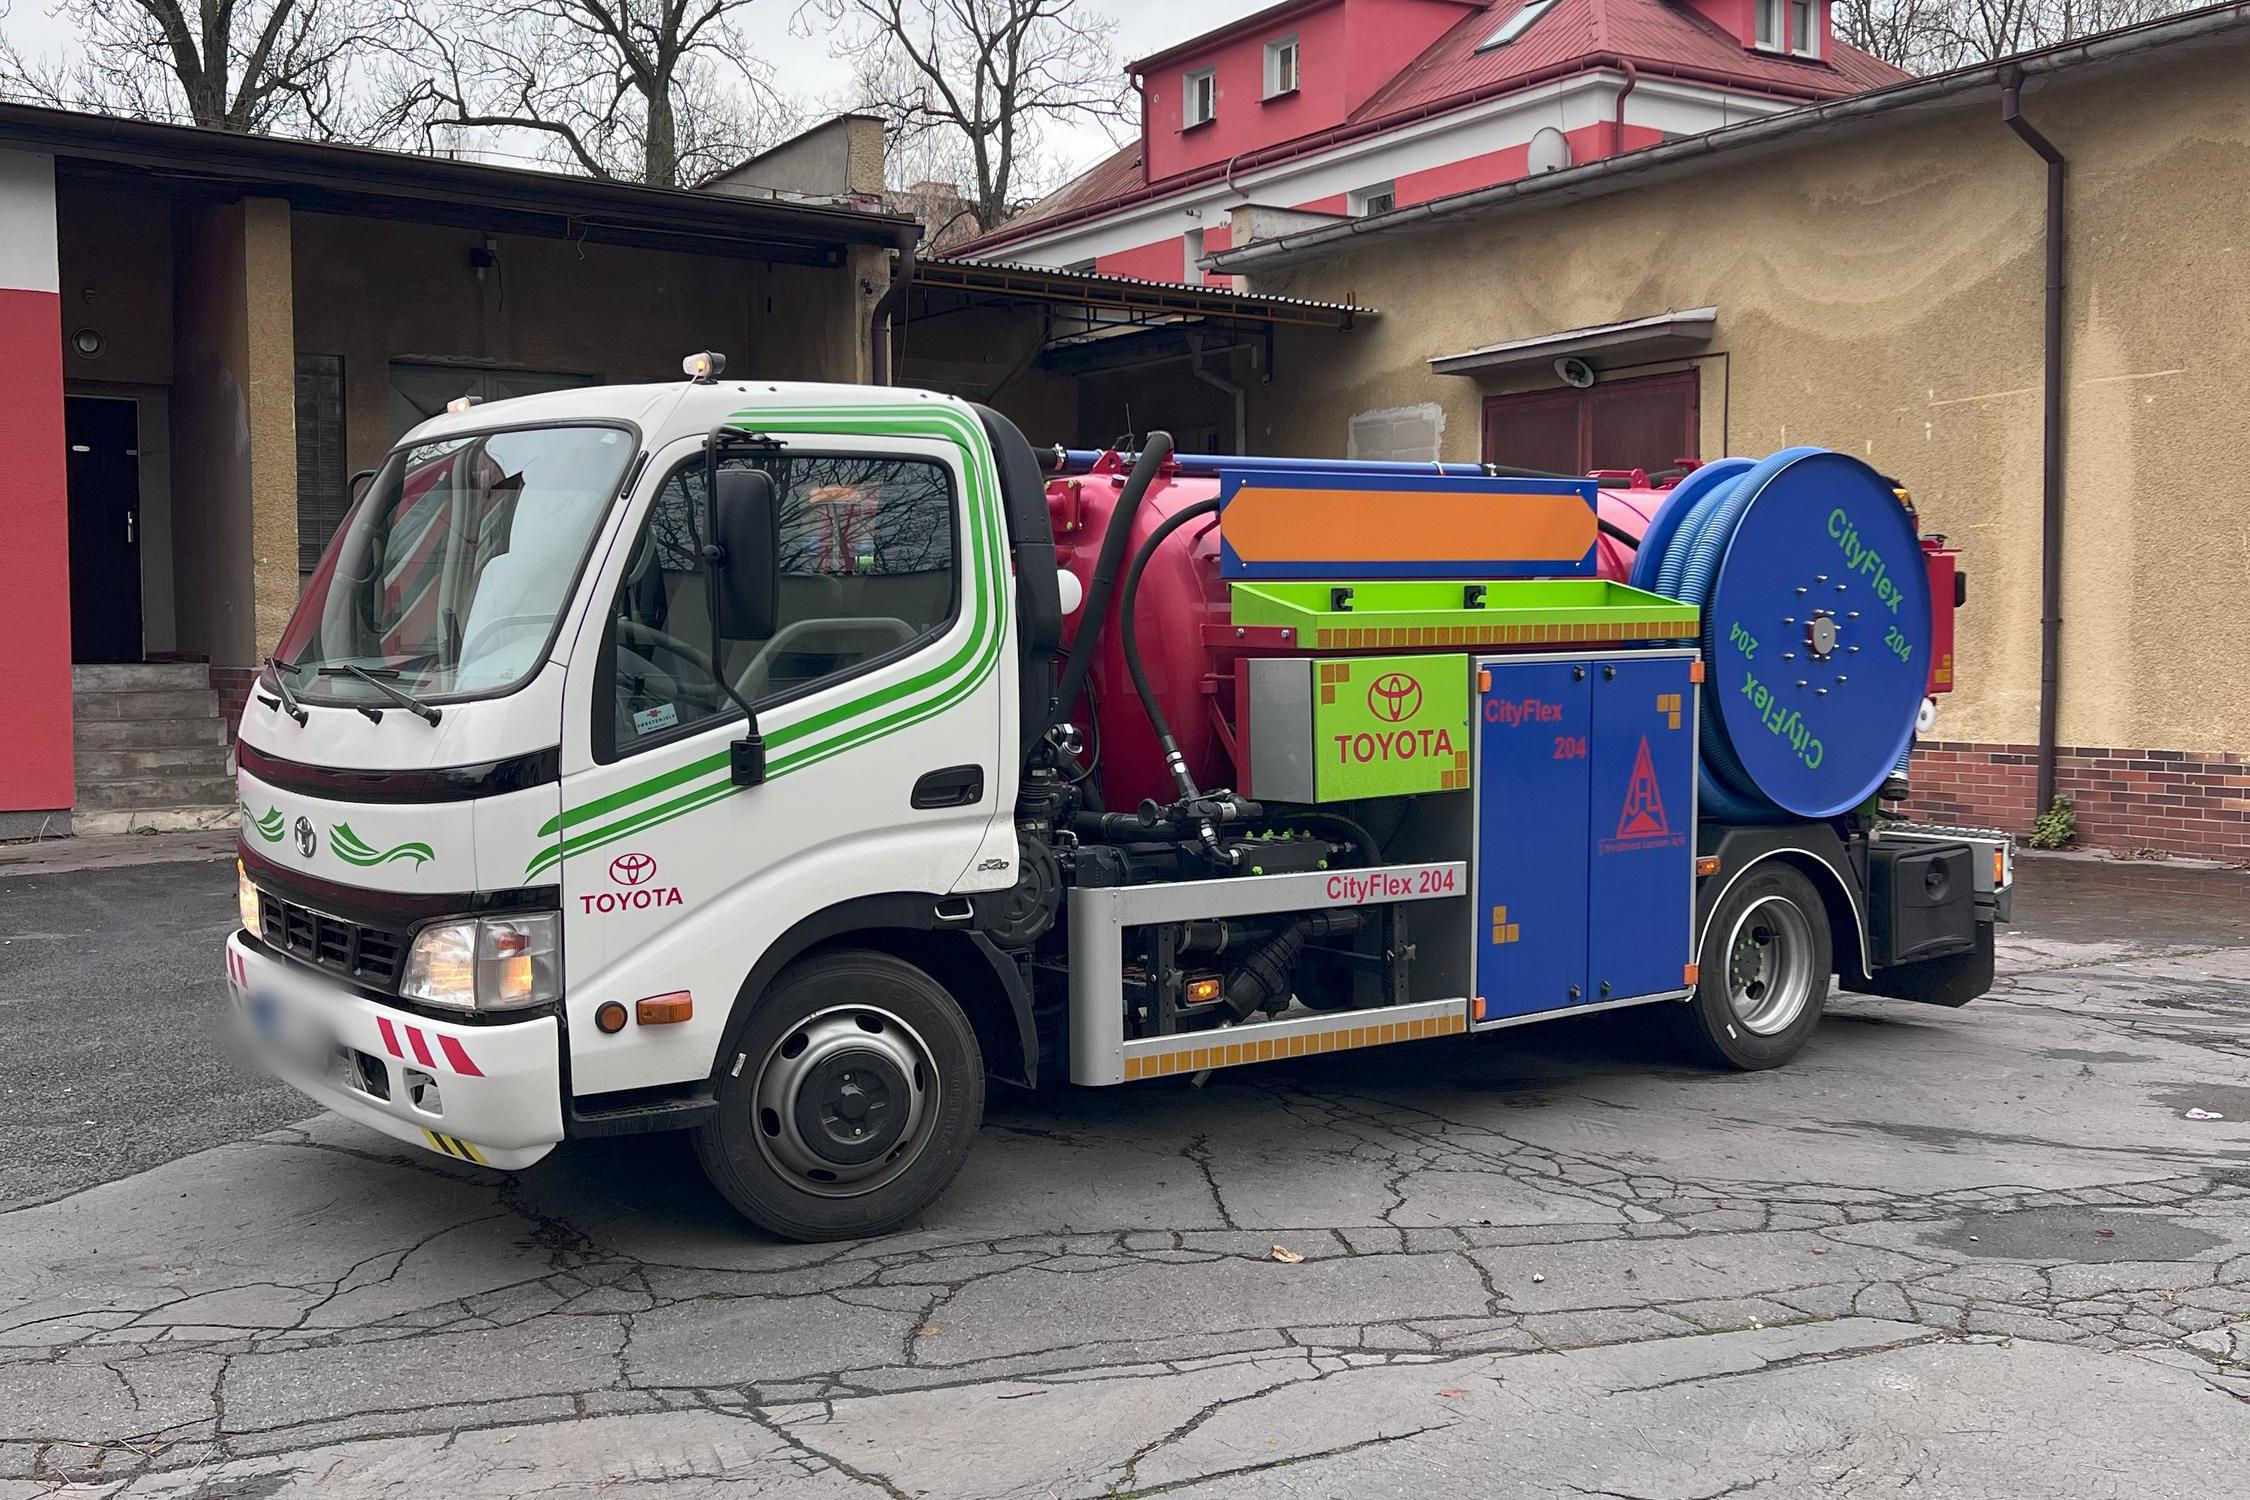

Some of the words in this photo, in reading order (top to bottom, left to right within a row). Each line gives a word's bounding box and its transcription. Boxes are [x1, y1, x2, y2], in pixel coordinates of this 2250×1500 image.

[1827, 507, 1904, 615] CityFlex
[1883, 625, 1913, 663] 204
[1729, 621, 1760, 661] 204
[1484, 699, 1562, 727] CityFlex
[1740, 671, 1824, 769] CityFlex
[1334, 728, 1454, 765] TOYOTA
[1553, 736, 1587, 760] 204
[580, 887, 684, 914] TOYOTA
[1326, 873, 1412, 905] CityFlex
[1418, 869, 1455, 894] 204
